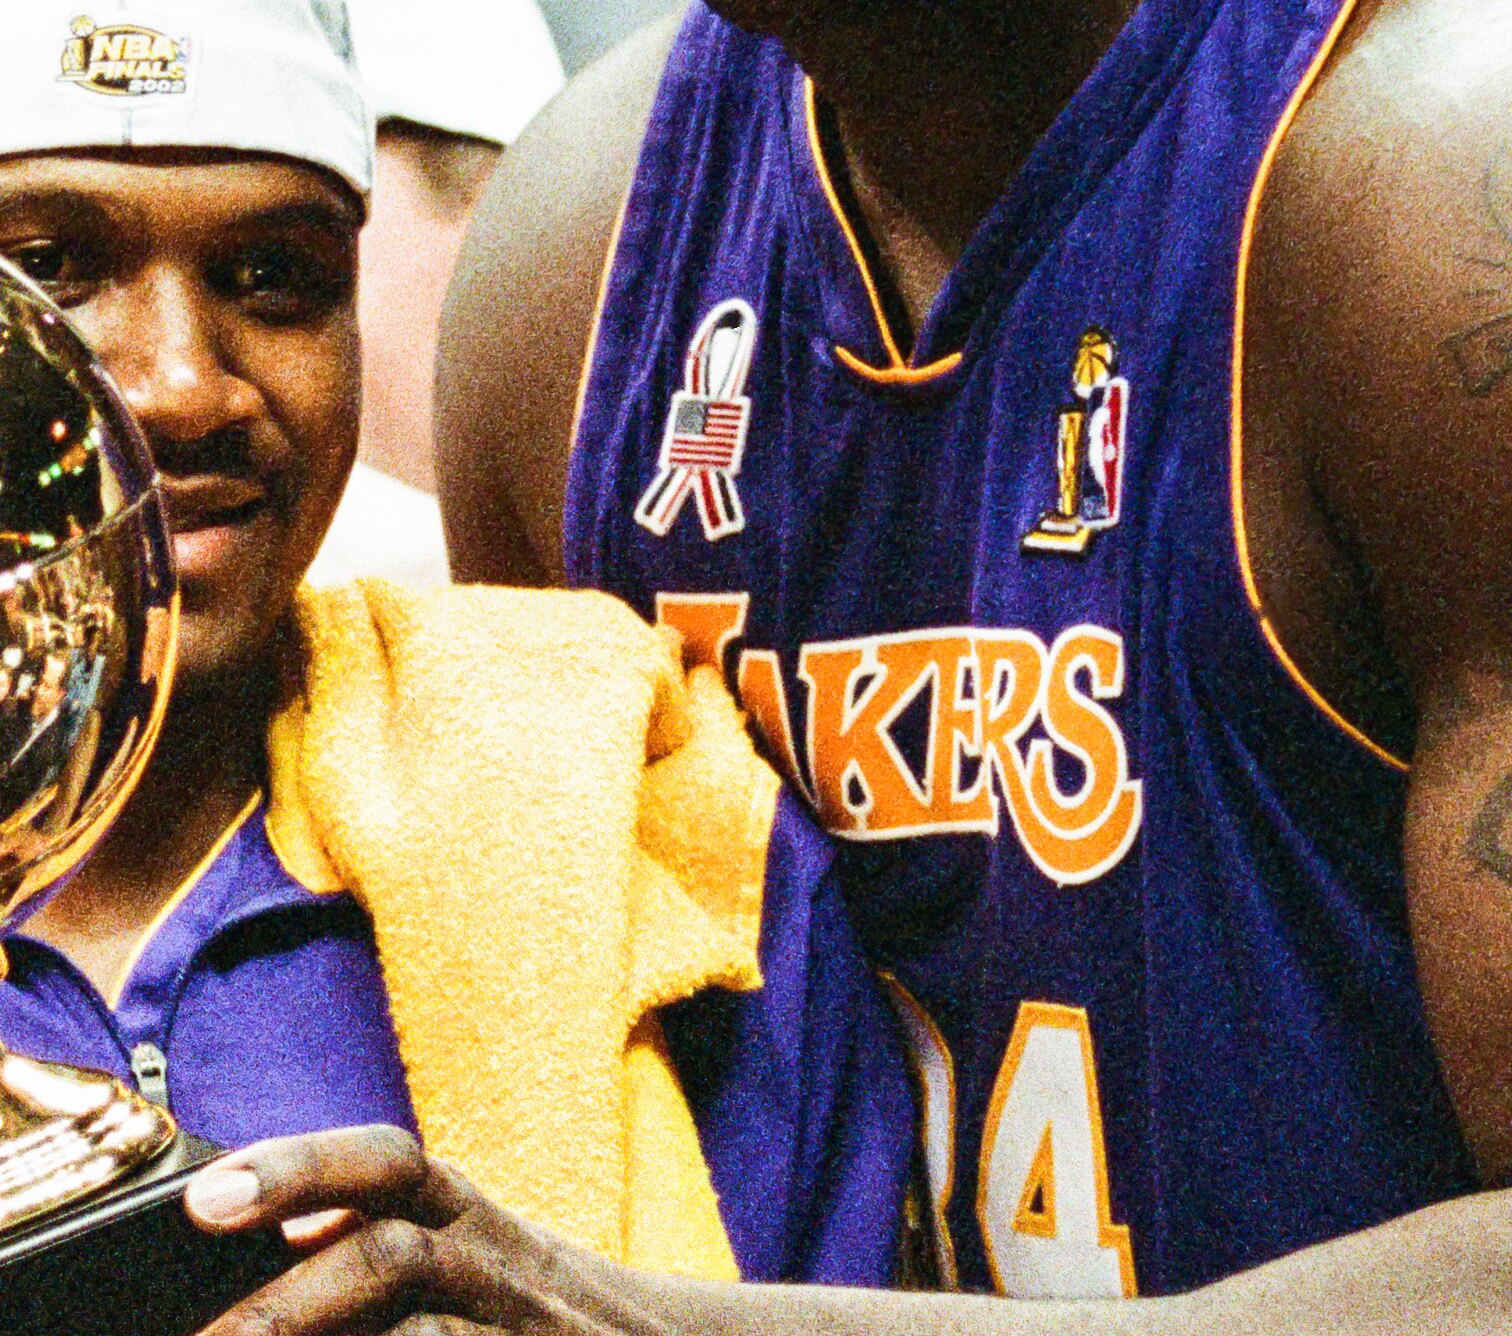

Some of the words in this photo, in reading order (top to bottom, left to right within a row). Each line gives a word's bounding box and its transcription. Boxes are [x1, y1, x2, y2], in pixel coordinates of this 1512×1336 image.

[89, 33, 177, 63] NBA
[88, 61, 186, 82] FINALS
[127, 78, 187, 95] 2002
